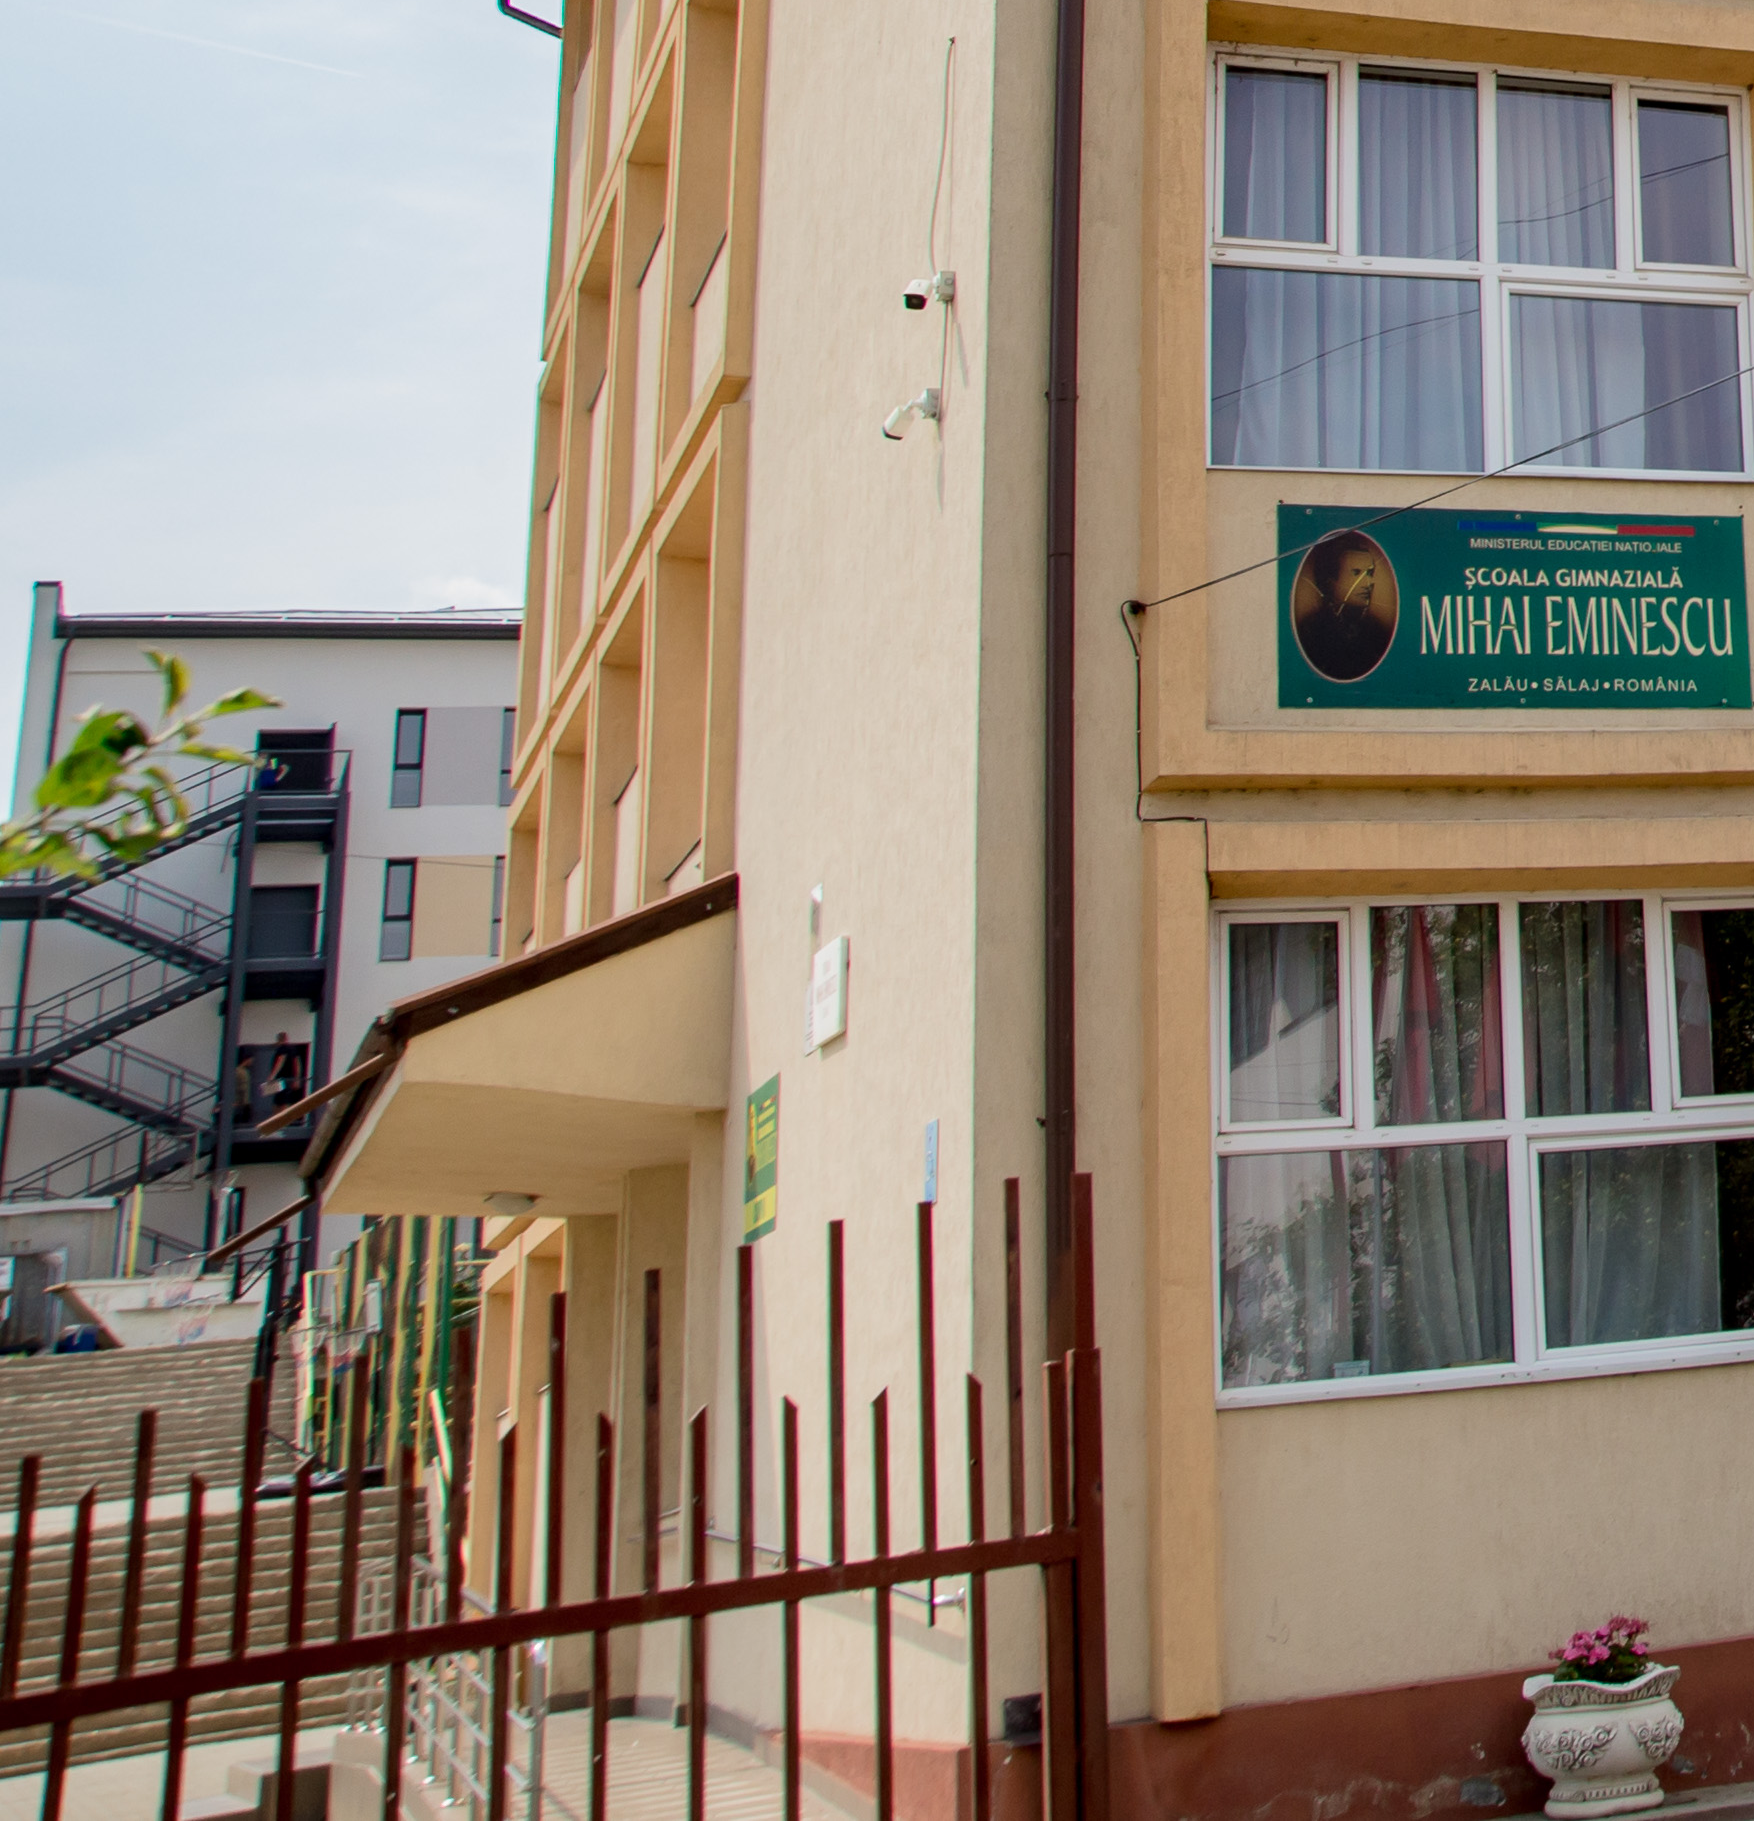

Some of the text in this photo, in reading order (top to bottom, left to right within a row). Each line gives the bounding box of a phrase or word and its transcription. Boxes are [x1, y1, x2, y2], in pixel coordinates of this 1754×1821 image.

[1470, 538, 1544, 550] MINISTERUL
[1465, 567, 1683, 590] ȘCOALA GIMNAZIALĂ
[1421, 596, 1733, 656] MIHAI EMINESCU
[1468, 676, 1697, 693] ZALĂU SĂLAJ ROMÂNIA
